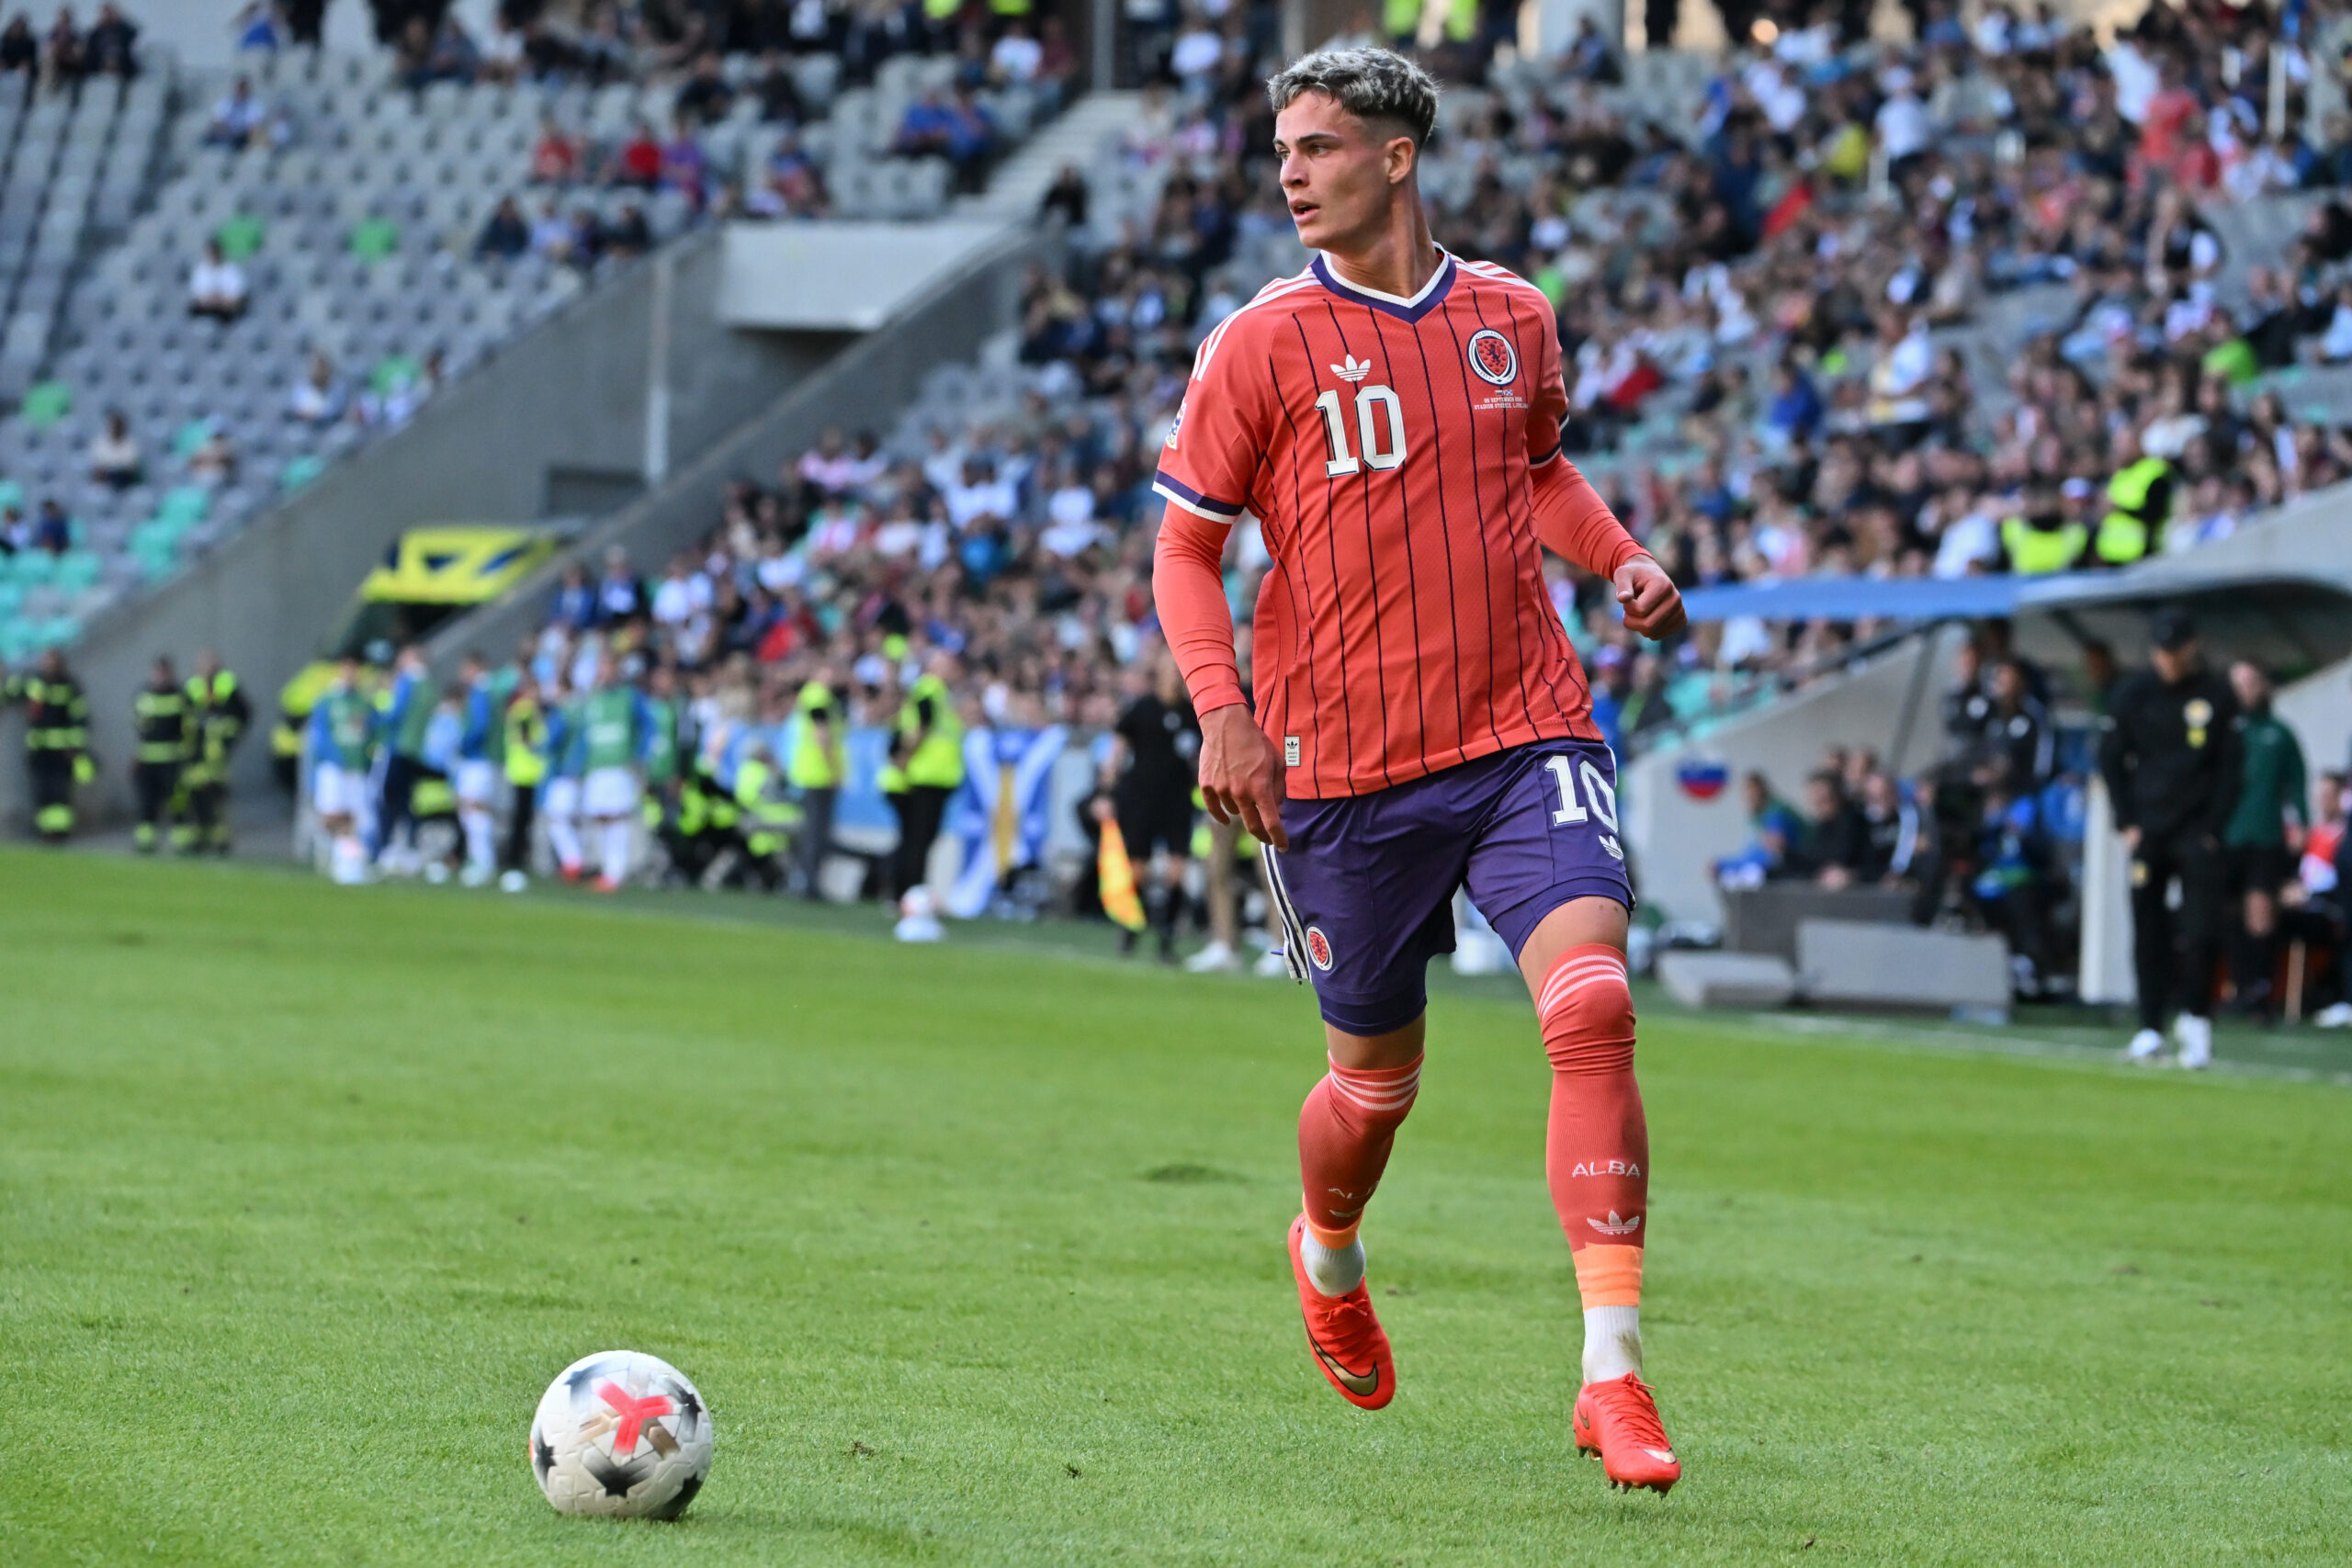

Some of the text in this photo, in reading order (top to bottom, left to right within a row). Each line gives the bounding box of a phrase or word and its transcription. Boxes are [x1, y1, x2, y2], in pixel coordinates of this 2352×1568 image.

[1315, 385, 1408, 478] 10
[1544, 755, 1619, 834] 10
[1572, 1160, 1641, 1179] ALBA
